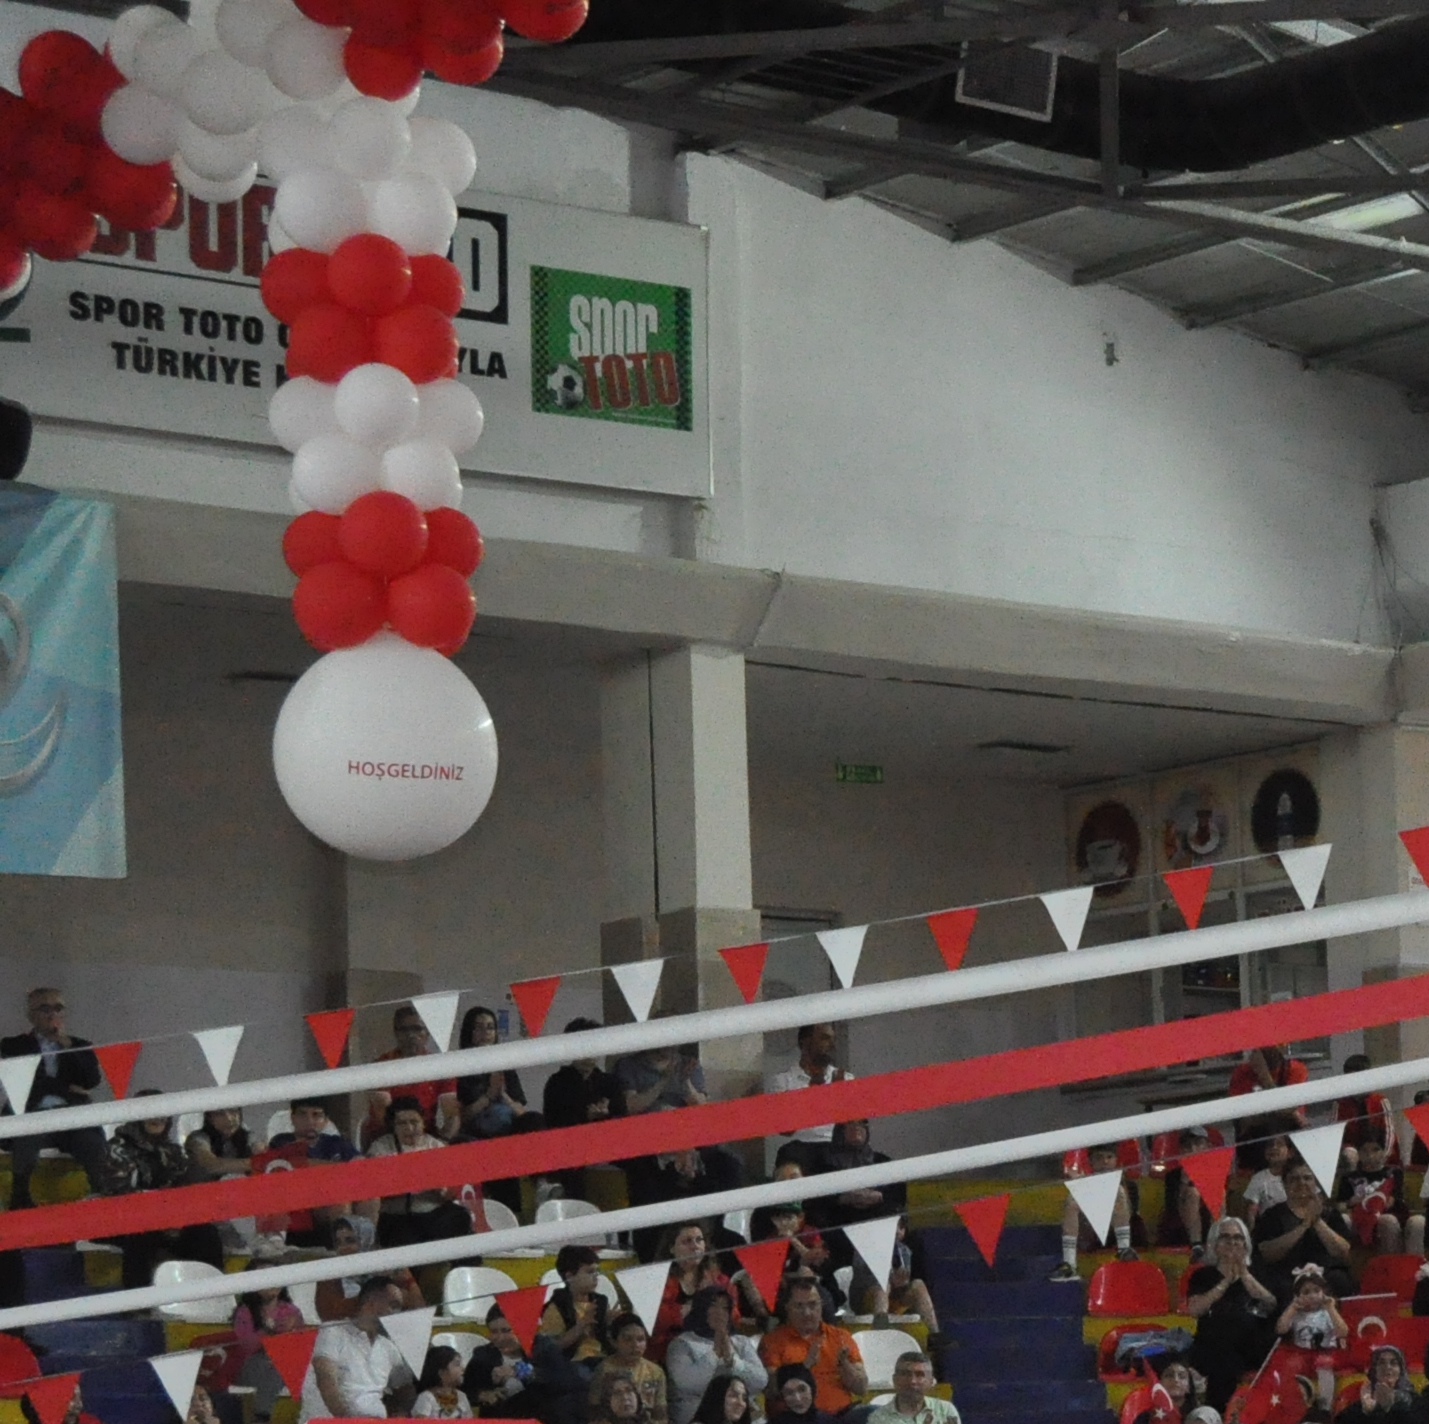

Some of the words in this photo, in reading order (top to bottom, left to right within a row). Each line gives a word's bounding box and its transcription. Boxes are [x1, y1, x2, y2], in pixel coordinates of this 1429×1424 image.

[68, 291, 165, 331] SPOR
[179, 306, 264, 349] TOTO
[111, 336, 261, 388] TÜRKİYE
[578, 352, 680, 411] TOTO
[347, 760, 465, 781] HOŞGELDİNİZ
